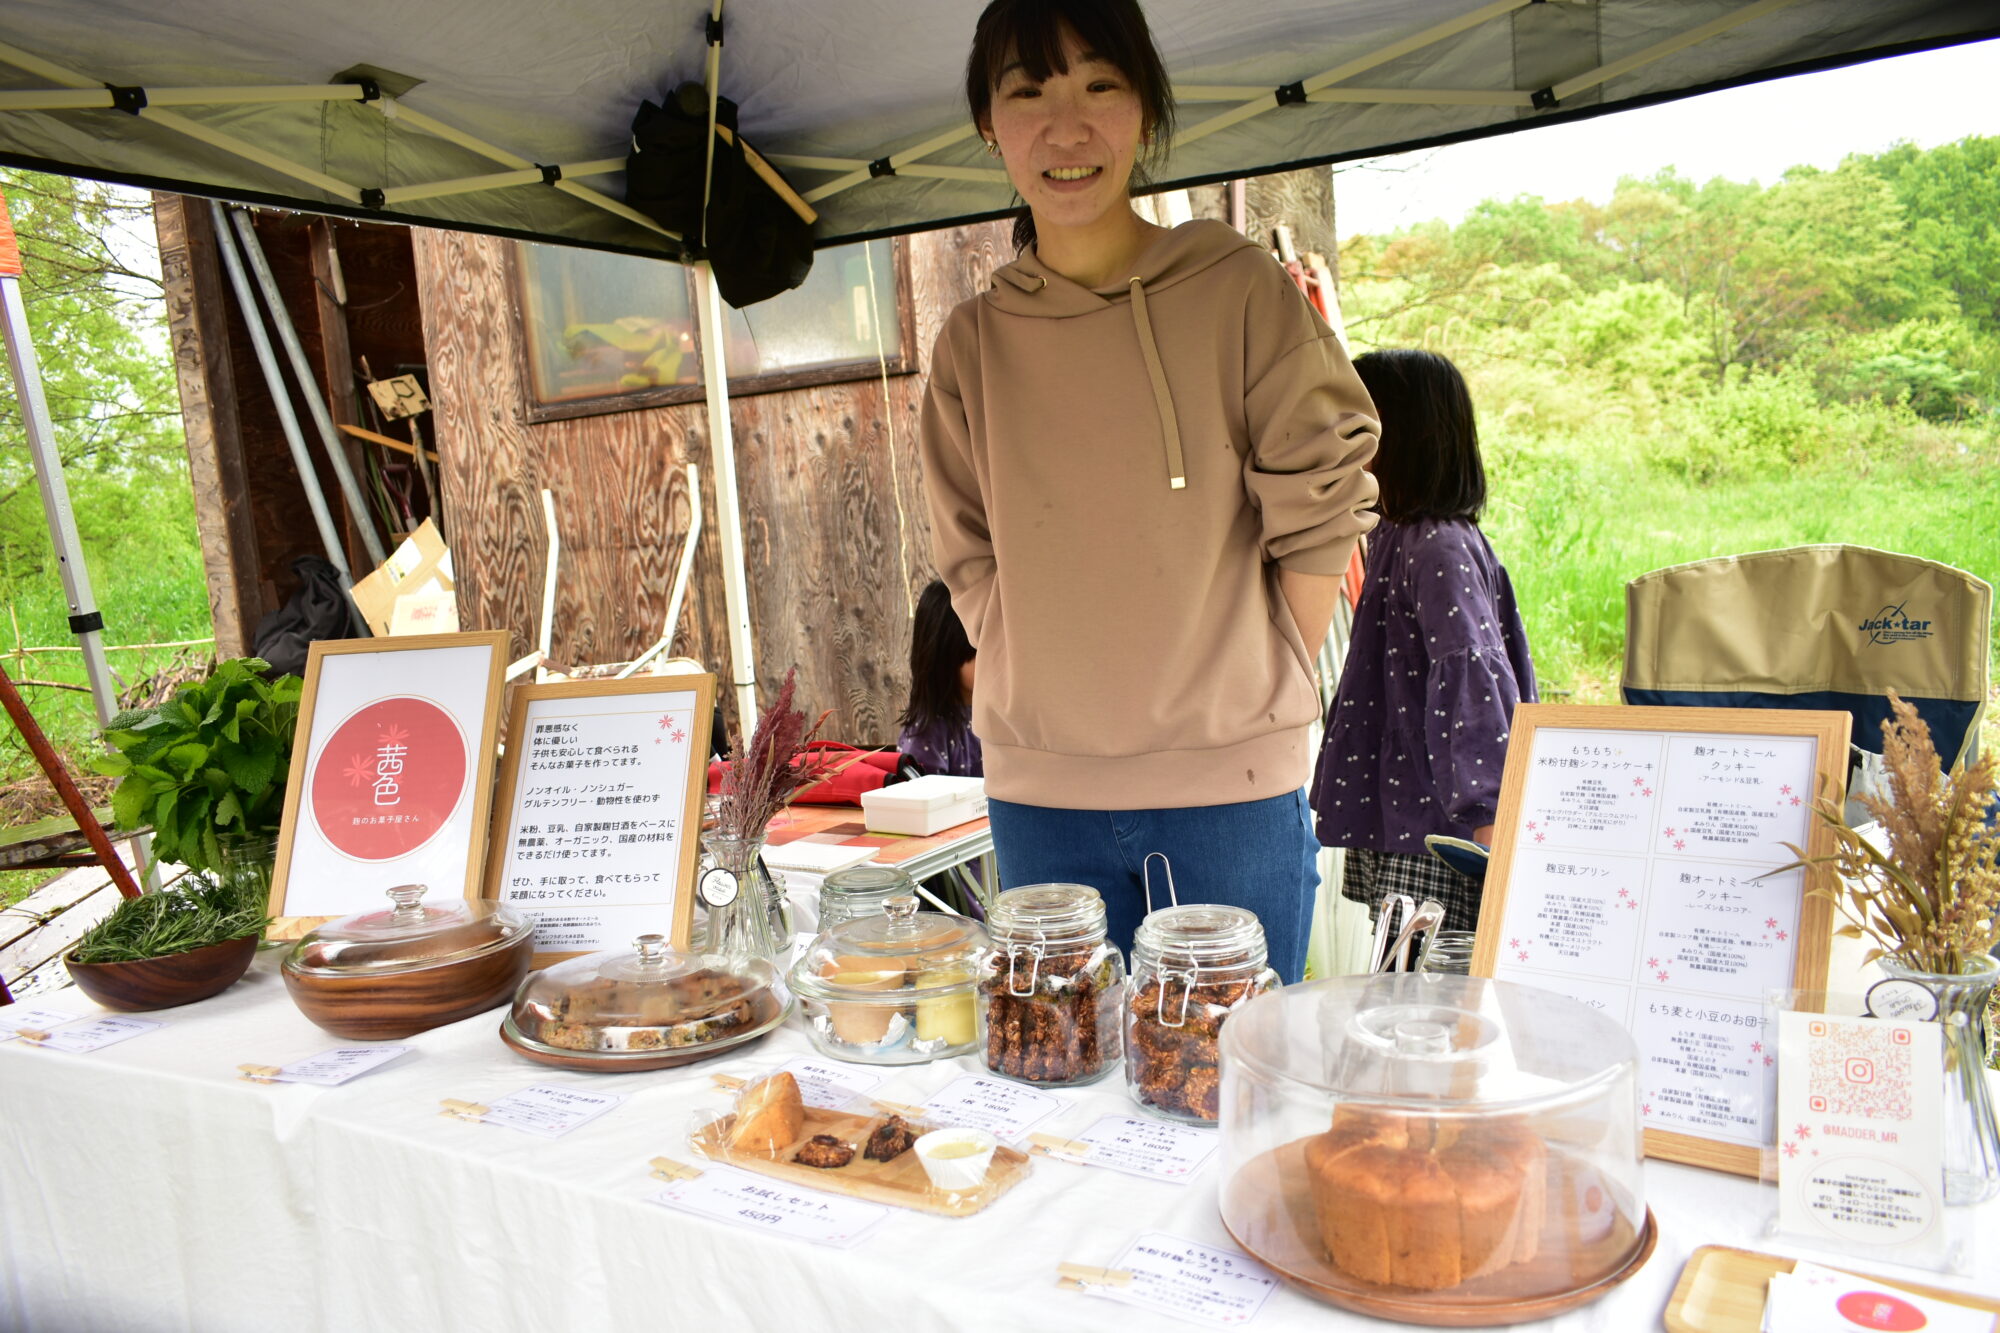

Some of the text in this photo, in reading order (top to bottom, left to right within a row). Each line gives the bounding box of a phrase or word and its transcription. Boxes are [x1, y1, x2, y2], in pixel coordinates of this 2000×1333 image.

[535, 723, 579, 733] 罪悪感なく
[533, 736, 578, 746] 体に優しい
[532, 745, 639, 759] 子供も安心して食べられる
[1572, 745, 1612, 757] もちもち
[1694, 746, 1777, 758] 麹オートミール
[530, 757, 642, 771] そんなお菓子を作ってます。
[1538, 757, 1653, 771] 米粉甘麹シフォンケーキ
[1711, 761, 1756, 771] クッキー
[372, 744, 408, 806] 茜色
[526, 783, 634, 796] ノンオイル・ノンシュガー
[524, 794, 660, 809] グルテンフリー・動物性を使わず
[352, 814, 419, 826] 麹のお菓子屋さん
[517, 848, 612, 860] できるだけ使ってます。
[1545, 863, 1610, 877] 麹豆乳プリン
[512, 873, 660, 887] ぜひ、手に取って、食べてもらって
[1680, 872, 1764, 888] 麹オートミール
[510, 889, 606, 900] 笑顔になってください。
[1697, 889, 1742, 901] クッキー
[1823, 1124, 1898, 1143] @MADDER_MR
[741, 1185, 830, 1211] お試しセット
[738, 1208, 782, 1224] 450円
